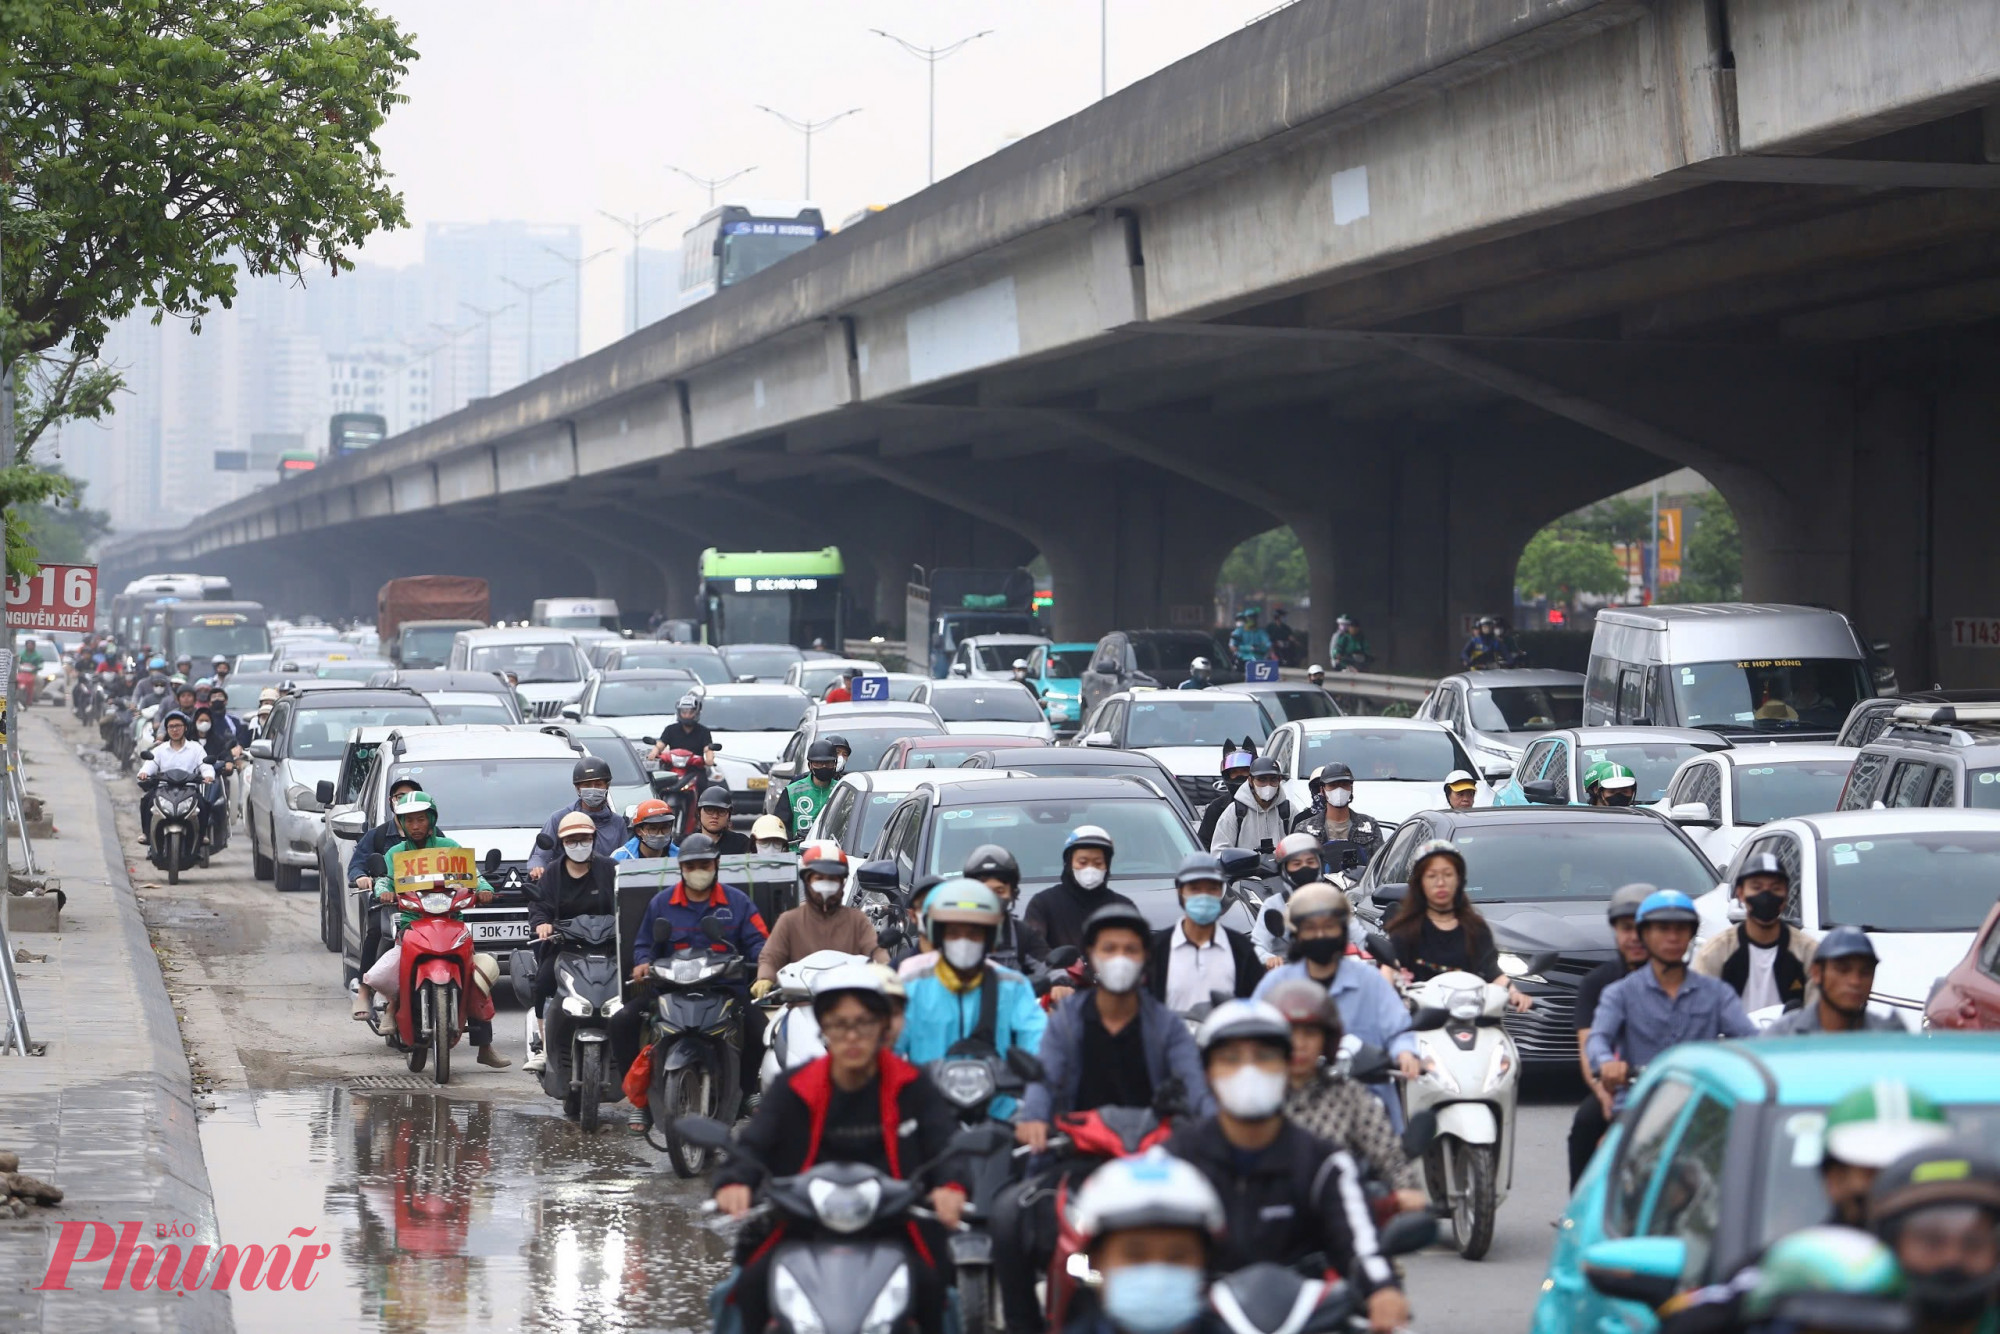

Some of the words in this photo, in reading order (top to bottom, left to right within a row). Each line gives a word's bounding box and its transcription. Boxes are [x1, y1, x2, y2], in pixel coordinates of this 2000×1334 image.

[5, 608, 55, 626] NGUYỄN
[58, 609, 89, 627] XIỂN
[1255, 663, 1272, 680] G7
[1752, 660, 1772, 668] HỢP
[861, 680, 881, 699] G7
[403, 857, 429, 876] XE
[437, 850, 467, 873] ÔM
